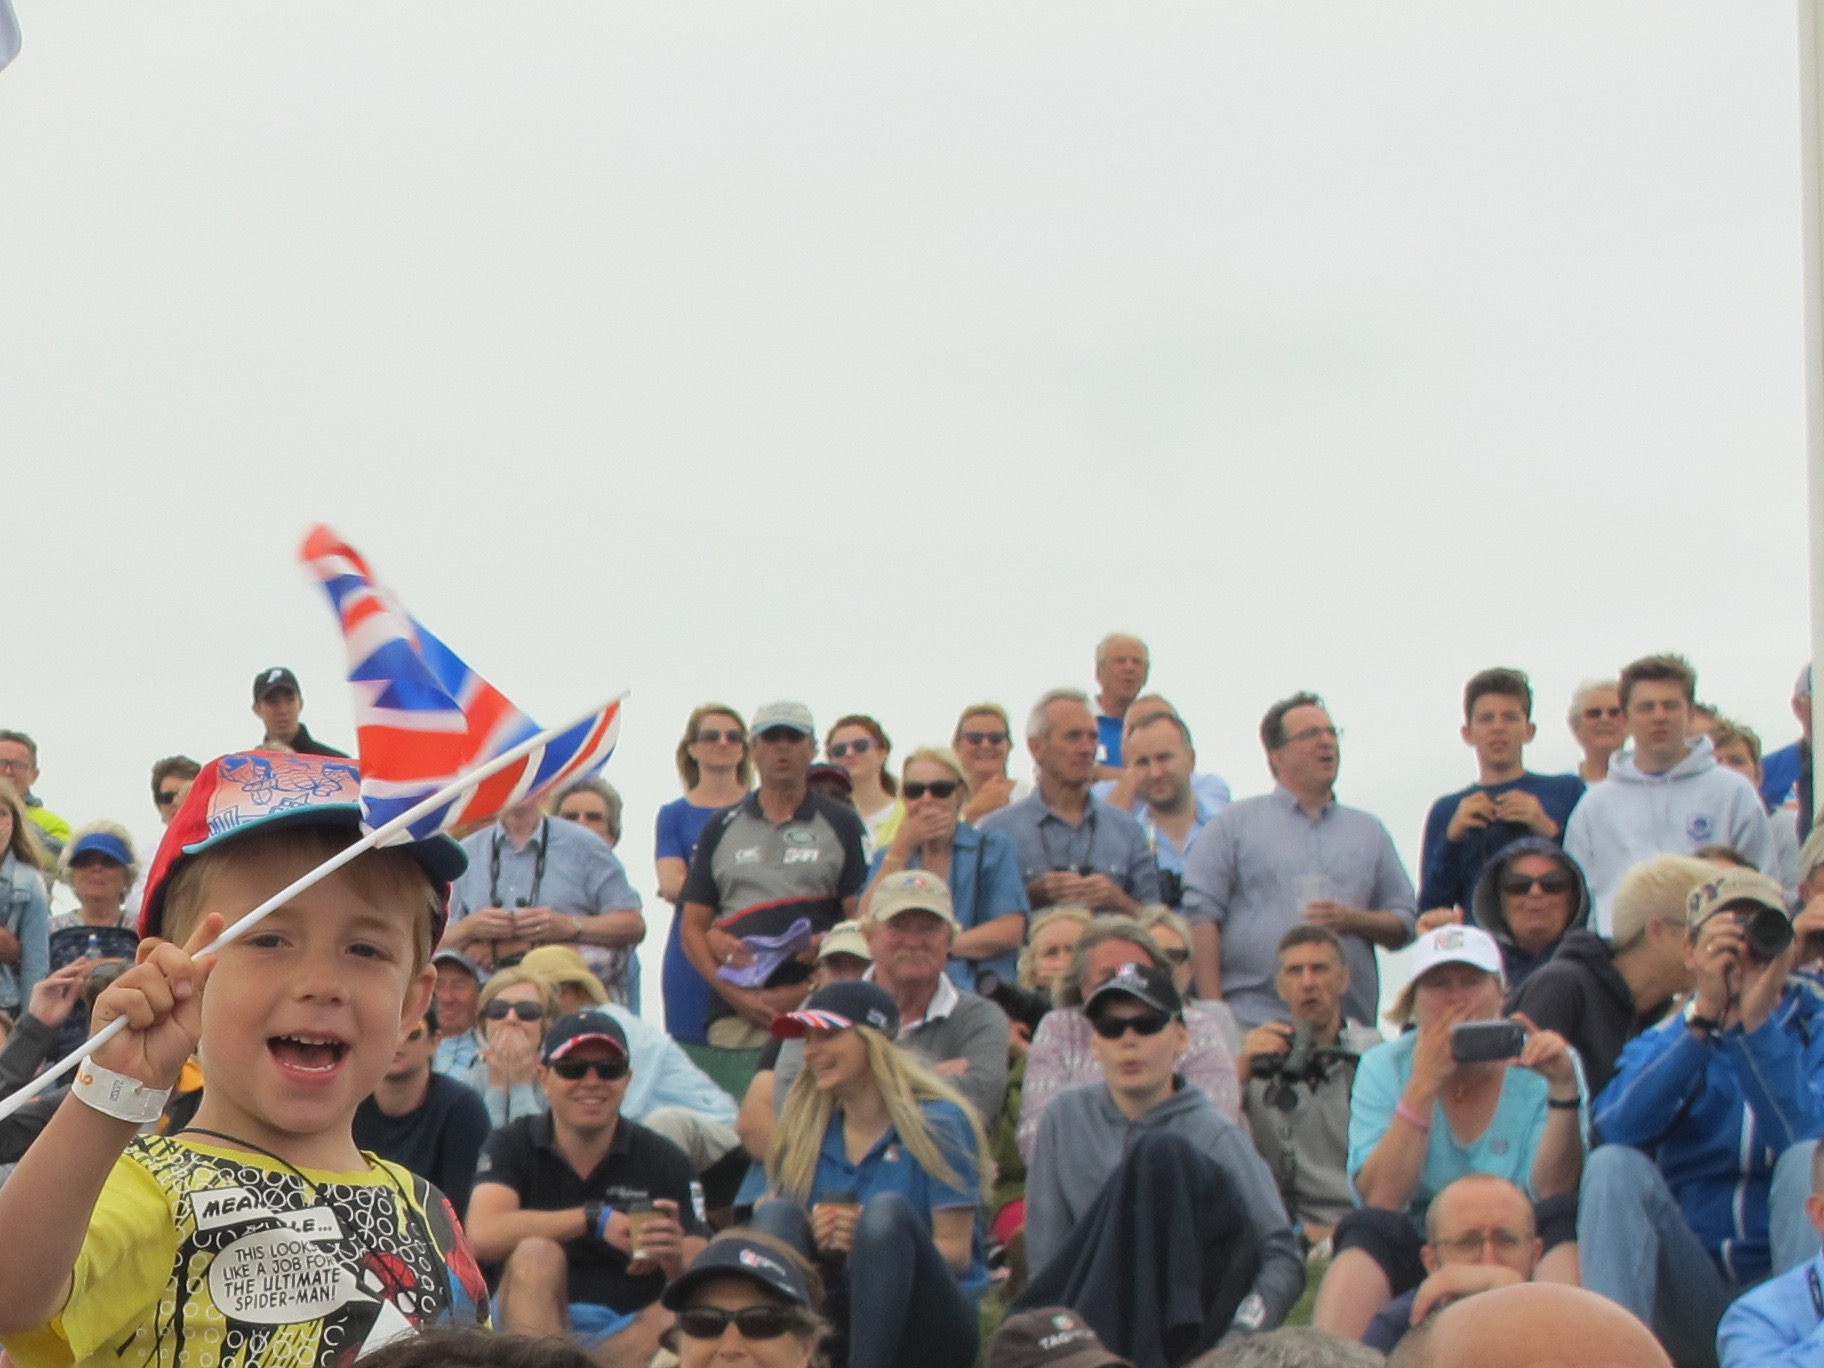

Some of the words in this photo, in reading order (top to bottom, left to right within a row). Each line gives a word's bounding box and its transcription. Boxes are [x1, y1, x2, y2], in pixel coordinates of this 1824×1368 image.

[223, 1263, 251, 1281] LIKE
[256, 1262, 266, 1277] A
[272, 1256, 302, 1274] JOB
[306, 1253, 337, 1270] FOR
[236, 1247, 264, 1262] THIS
[224, 1278, 255, 1298] THE
[263, 1267, 341, 1292] ULTIMATE
[234, 1285, 337, 1312] SPIDER-MAN!
